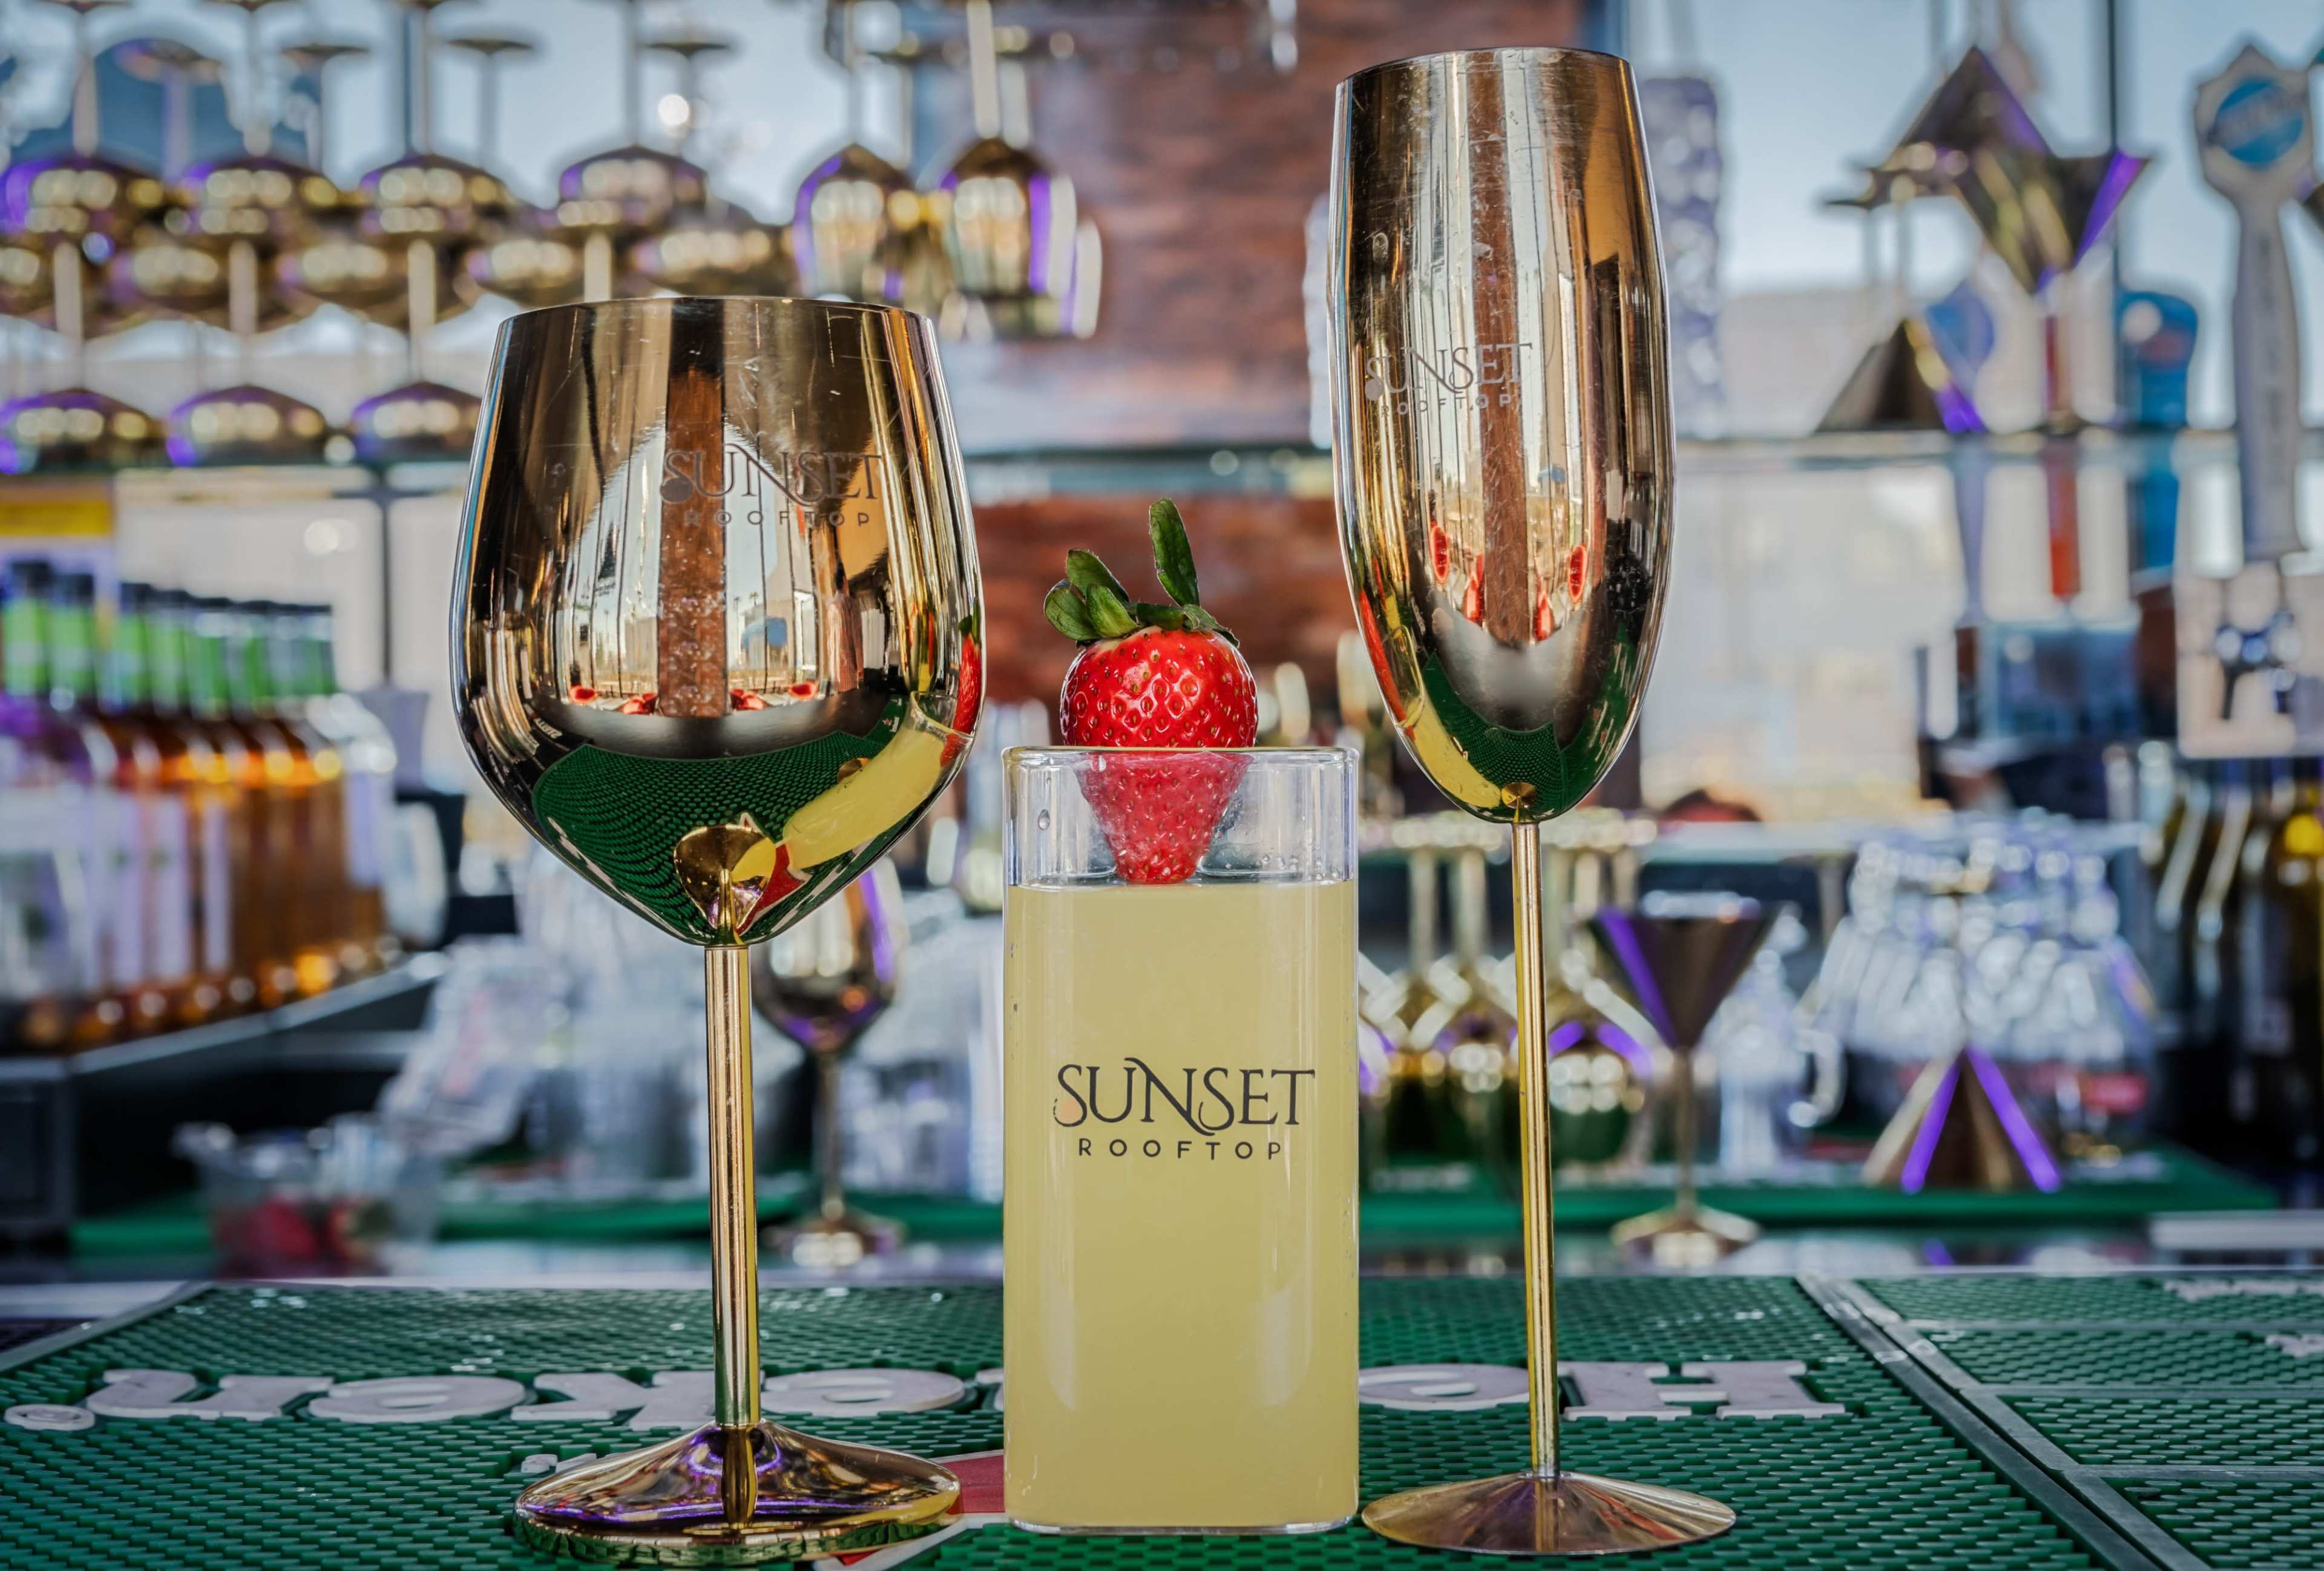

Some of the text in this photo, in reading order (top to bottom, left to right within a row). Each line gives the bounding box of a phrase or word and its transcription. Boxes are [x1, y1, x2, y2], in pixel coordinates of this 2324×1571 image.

[1365, 343, 1533, 401] SUNSET
[1381, 393, 1512, 417] ROOFTOP
[660, 443, 882, 507] SUNSET
[684, 511, 870, 526] ROOFTOP
[1052, 1057, 1316, 1136] SUNSET
[1078, 1138, 1281, 1161] ROOFTOP
